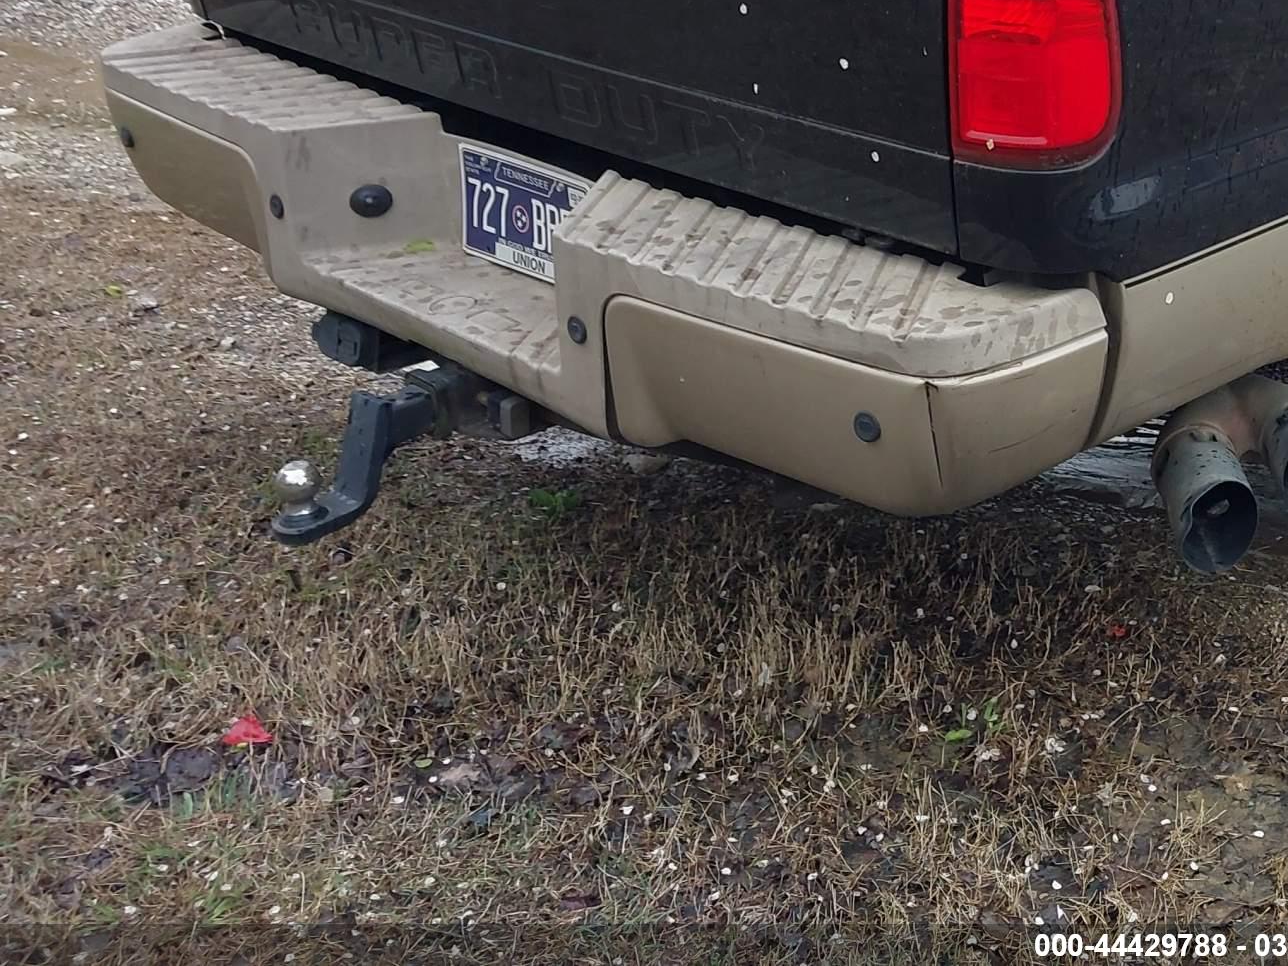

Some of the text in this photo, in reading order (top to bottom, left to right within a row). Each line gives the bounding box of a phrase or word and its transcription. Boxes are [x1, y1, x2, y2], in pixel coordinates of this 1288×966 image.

[501, 166, 551, 192] TENNESSEE
[467, 177, 509, 238] 727
[512, 250, 546, 275] UNION
